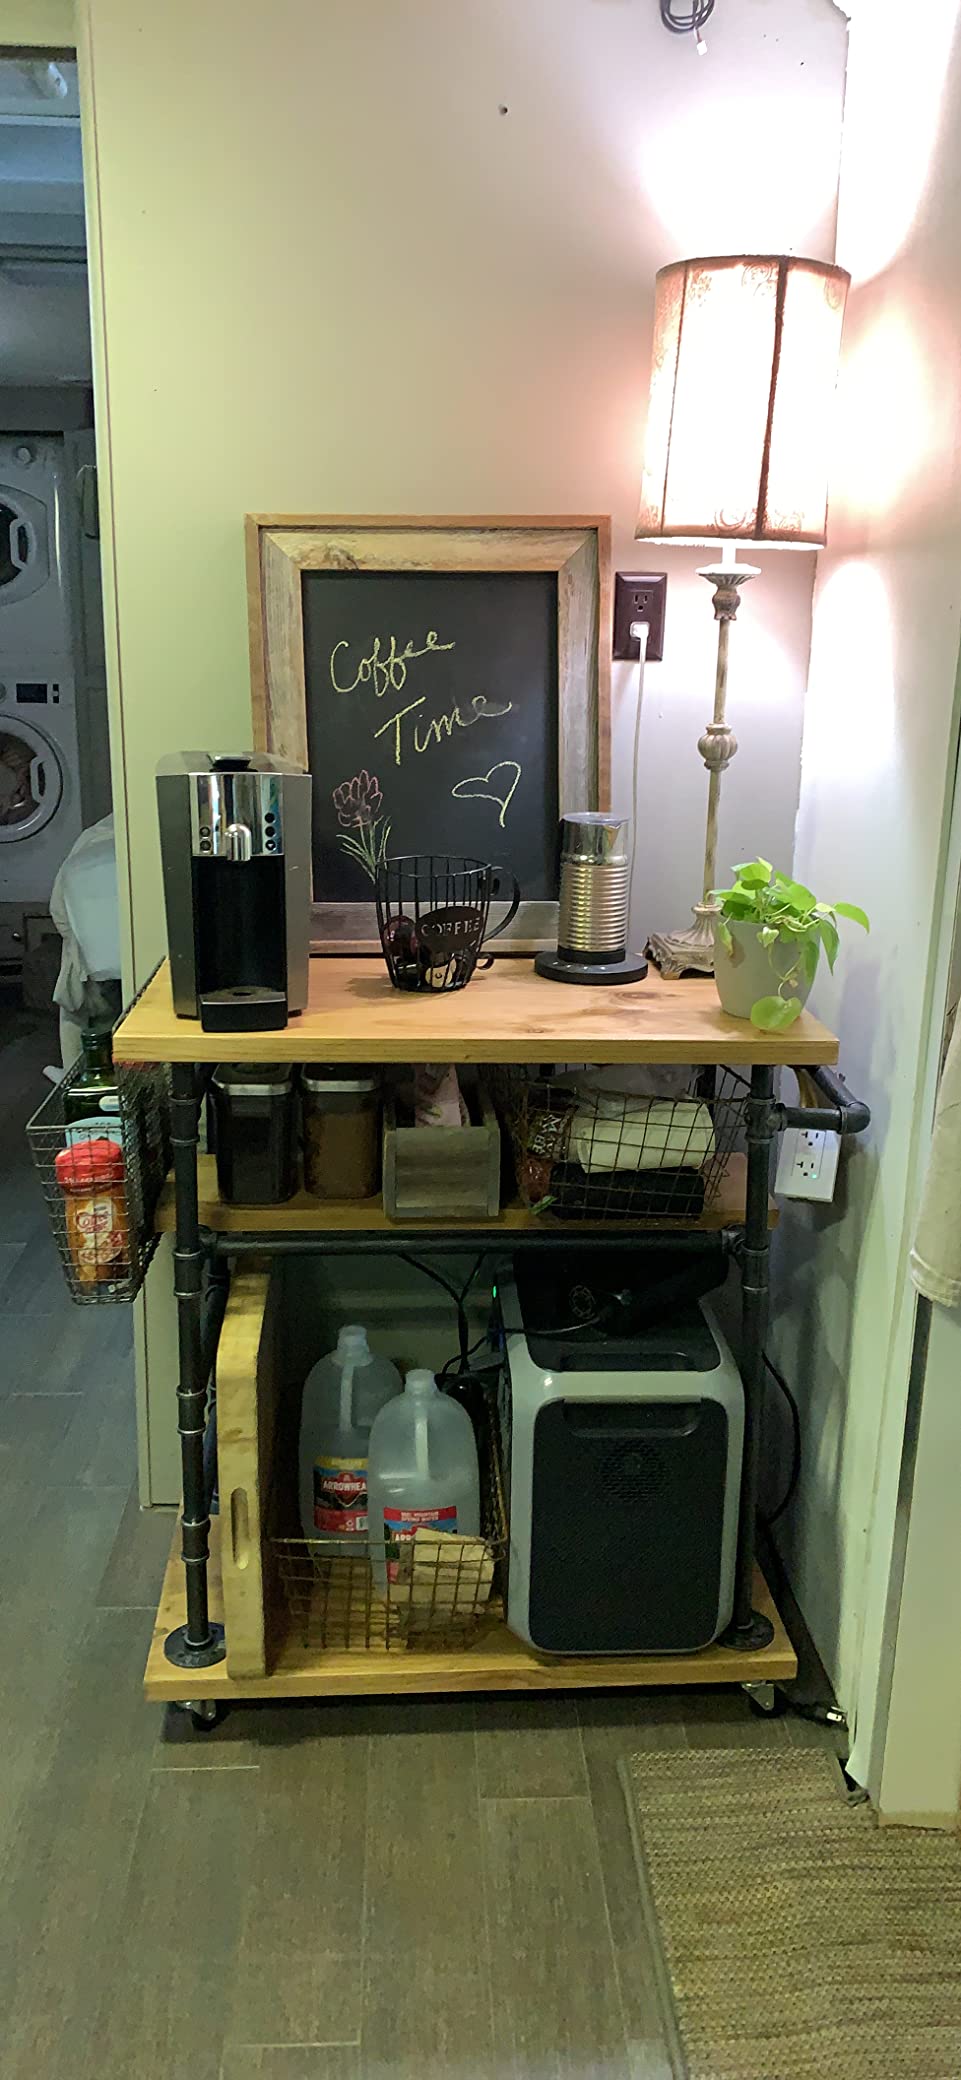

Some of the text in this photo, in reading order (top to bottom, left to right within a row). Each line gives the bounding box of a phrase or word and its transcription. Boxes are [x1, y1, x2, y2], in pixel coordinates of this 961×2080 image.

[329, 630, 456, 697] Coffee
[374, 695, 513, 766] Time
[420, 916, 481, 937] COFFEE
[322, 1480, 367, 1491] ARROWHEA
